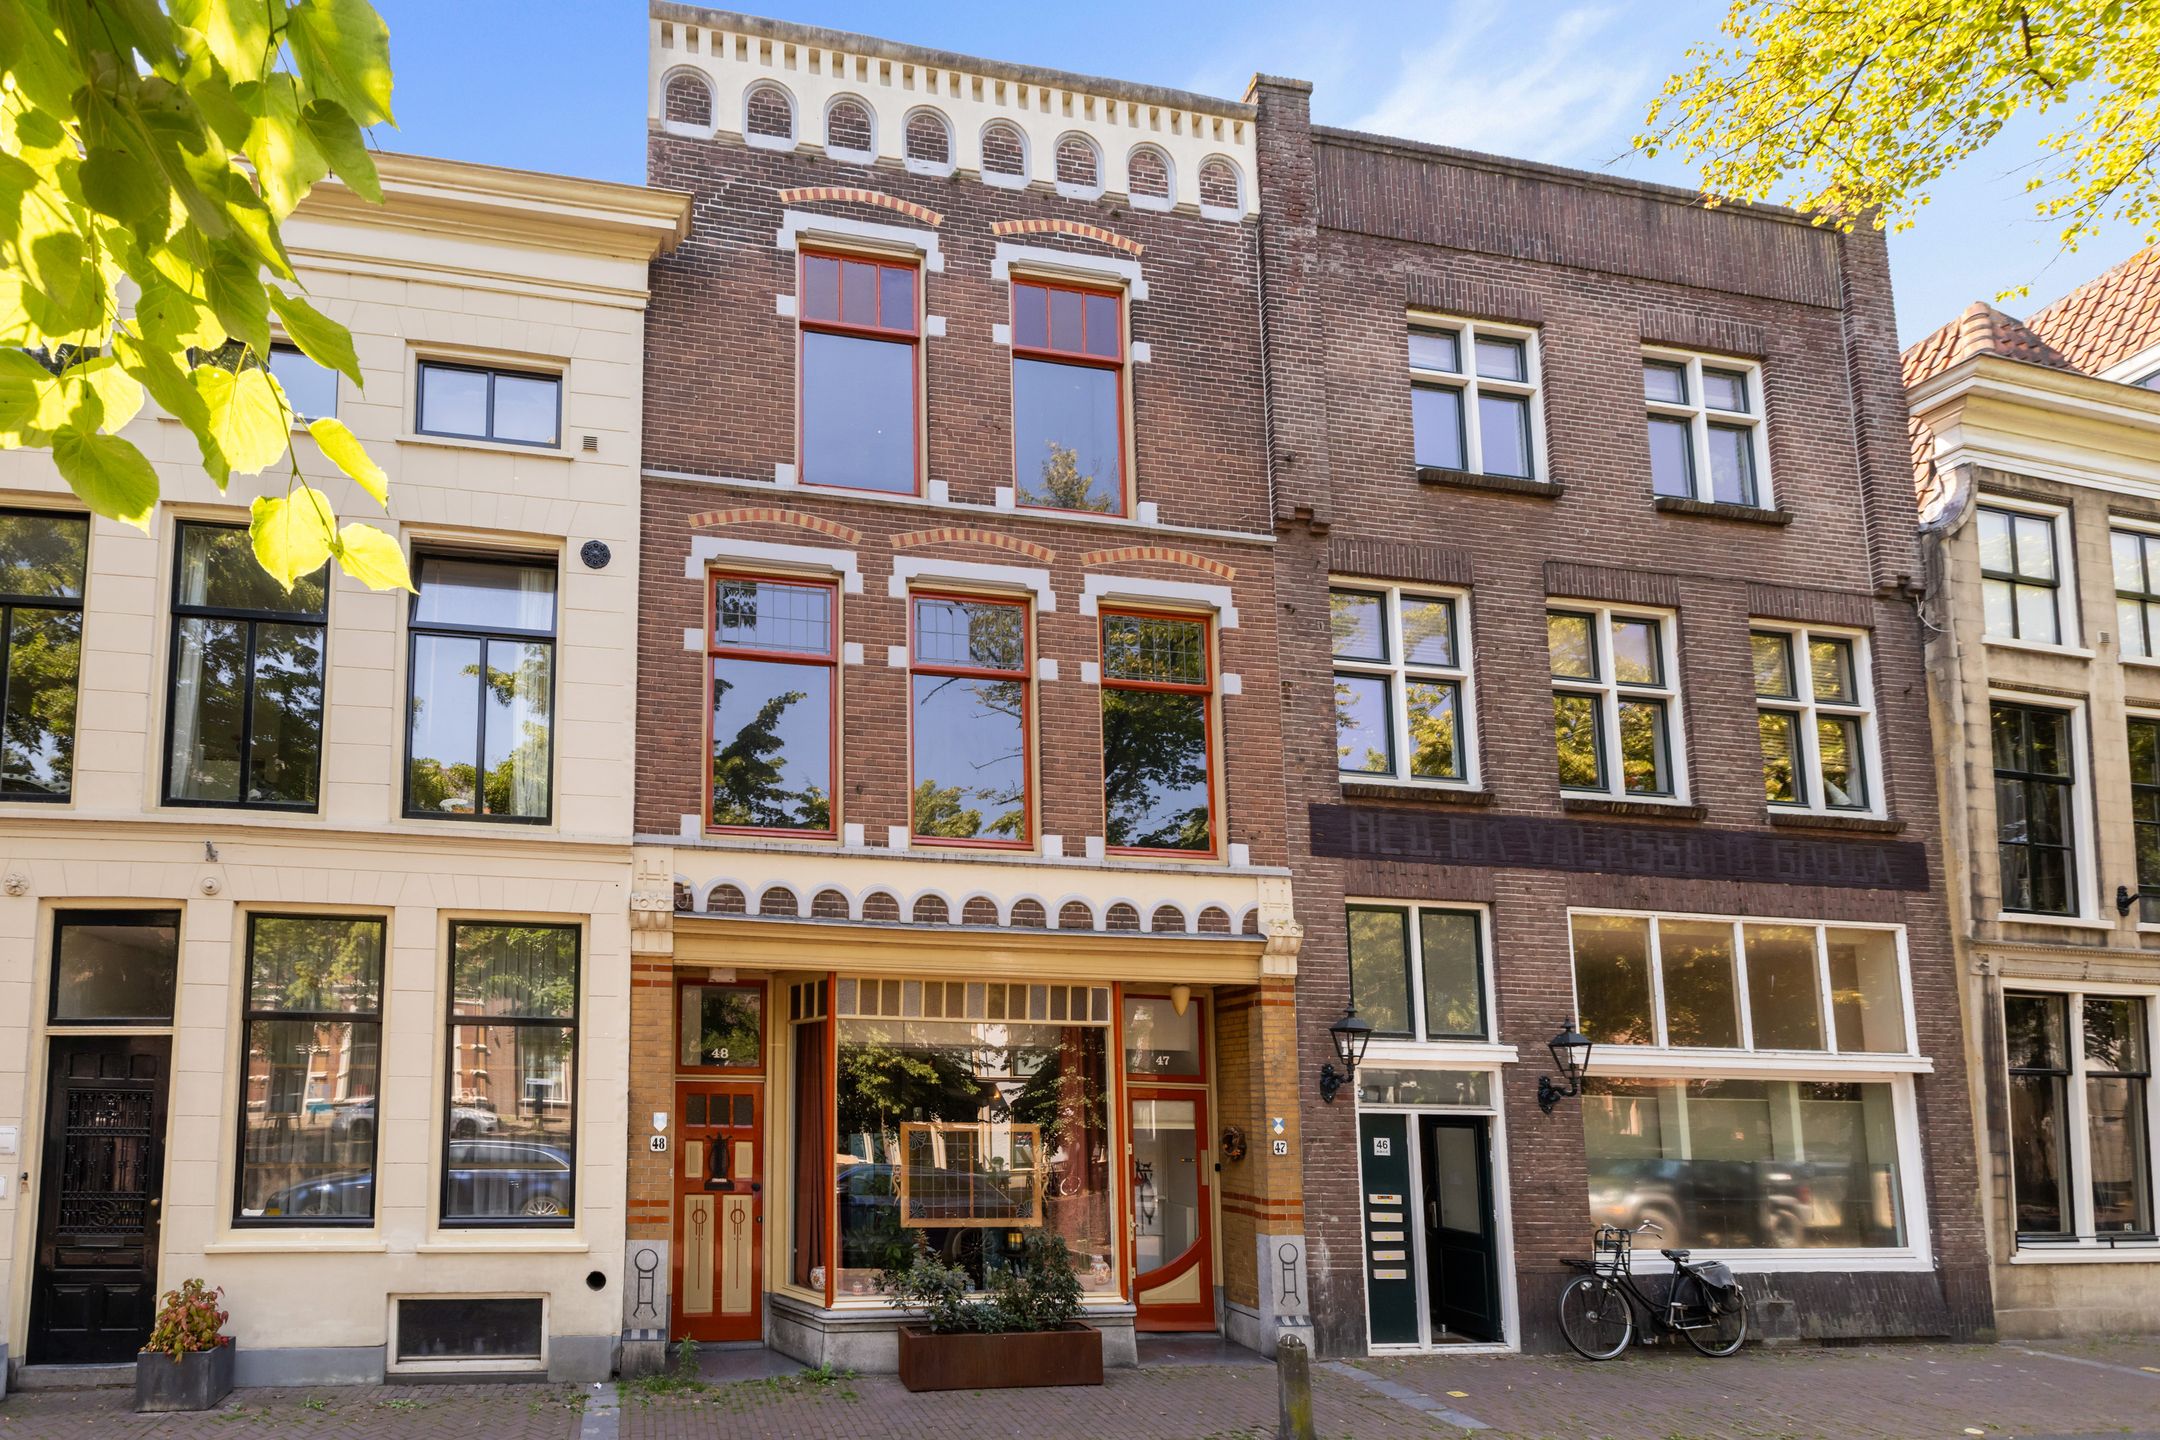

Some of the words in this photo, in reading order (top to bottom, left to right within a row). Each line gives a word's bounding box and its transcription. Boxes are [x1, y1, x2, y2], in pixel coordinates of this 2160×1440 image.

[711, 1047, 729, 1059] 48
[1155, 1055, 1170, 1066] 47
[651, 1137, 665, 1150] 48
[1274, 1142, 1286, 1153] 47
[1376, 1140, 1389, 1150] 46
